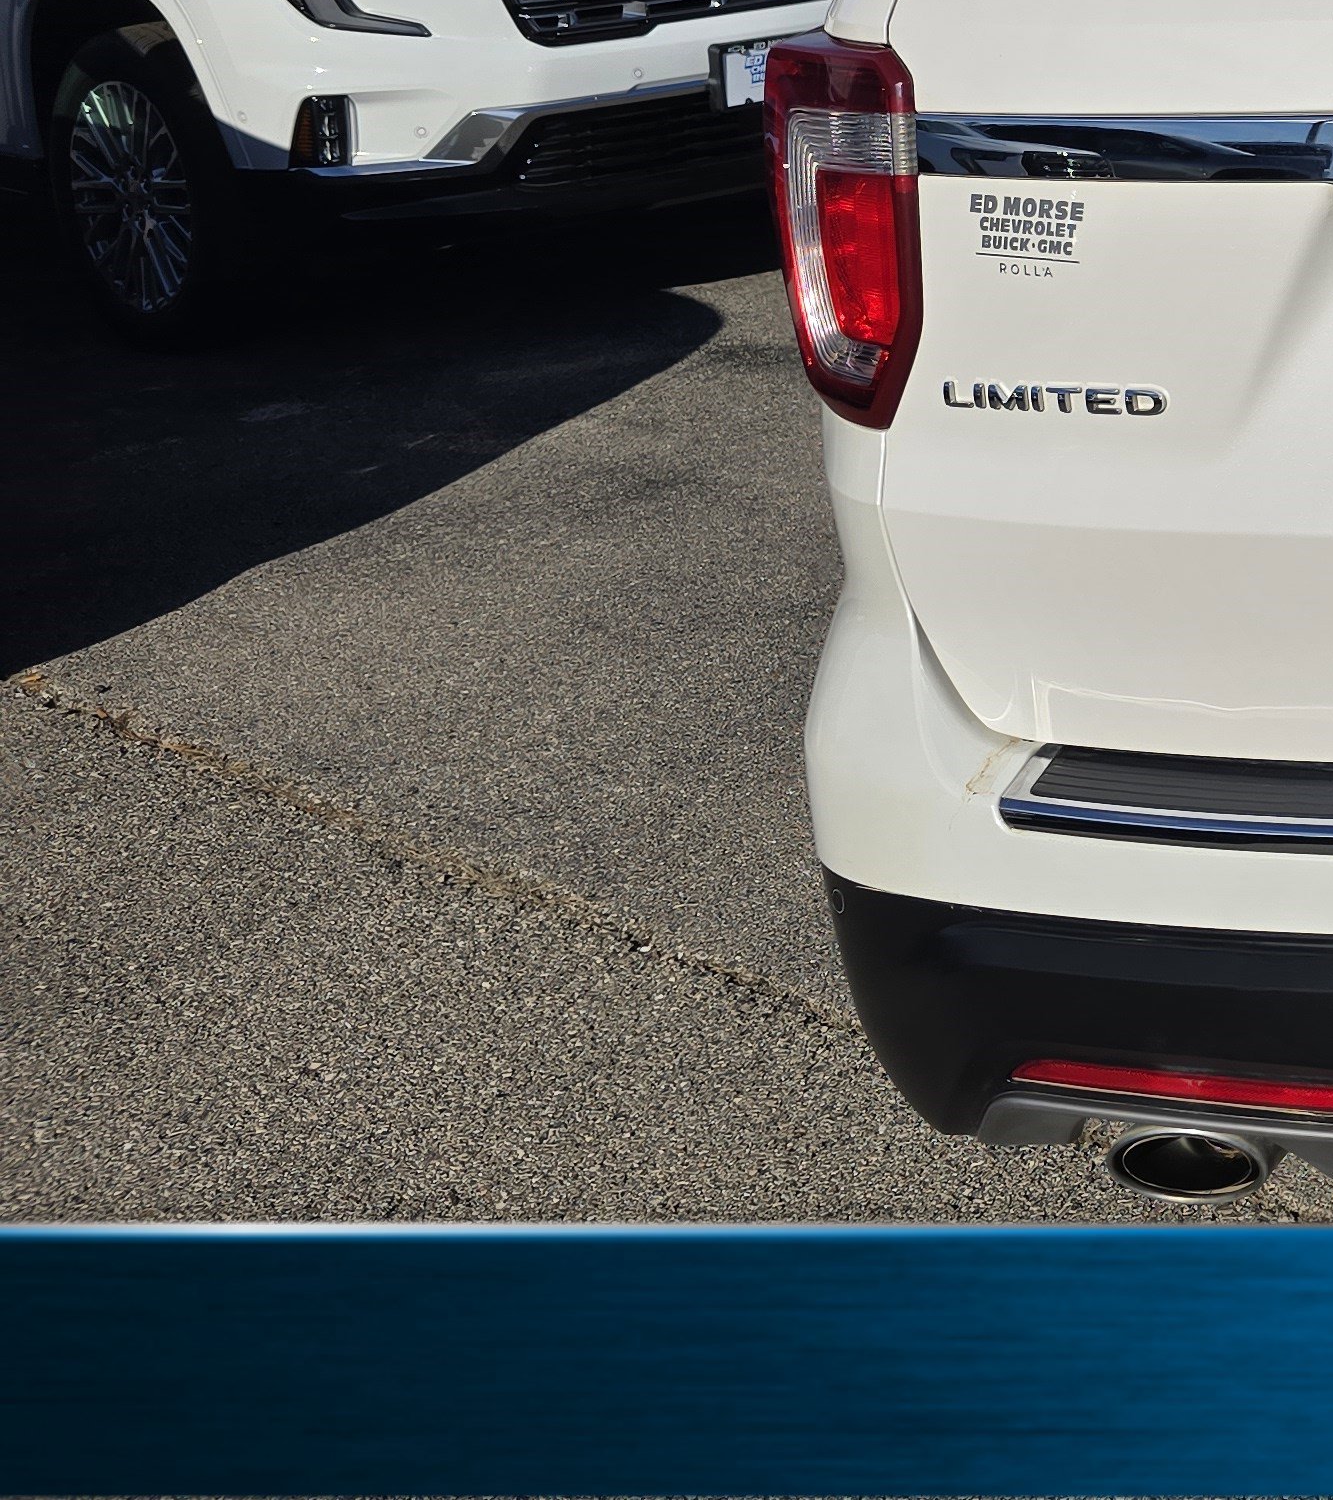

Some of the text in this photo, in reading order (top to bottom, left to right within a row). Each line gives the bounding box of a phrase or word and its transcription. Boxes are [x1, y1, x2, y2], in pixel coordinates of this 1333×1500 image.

[969, 193, 1085, 222] ED MORSE
[979, 216, 1077, 238] CHEVROLET
[999, 263, 1053, 277] ROLLA
[943, 380, 1168, 416] LIMITED
